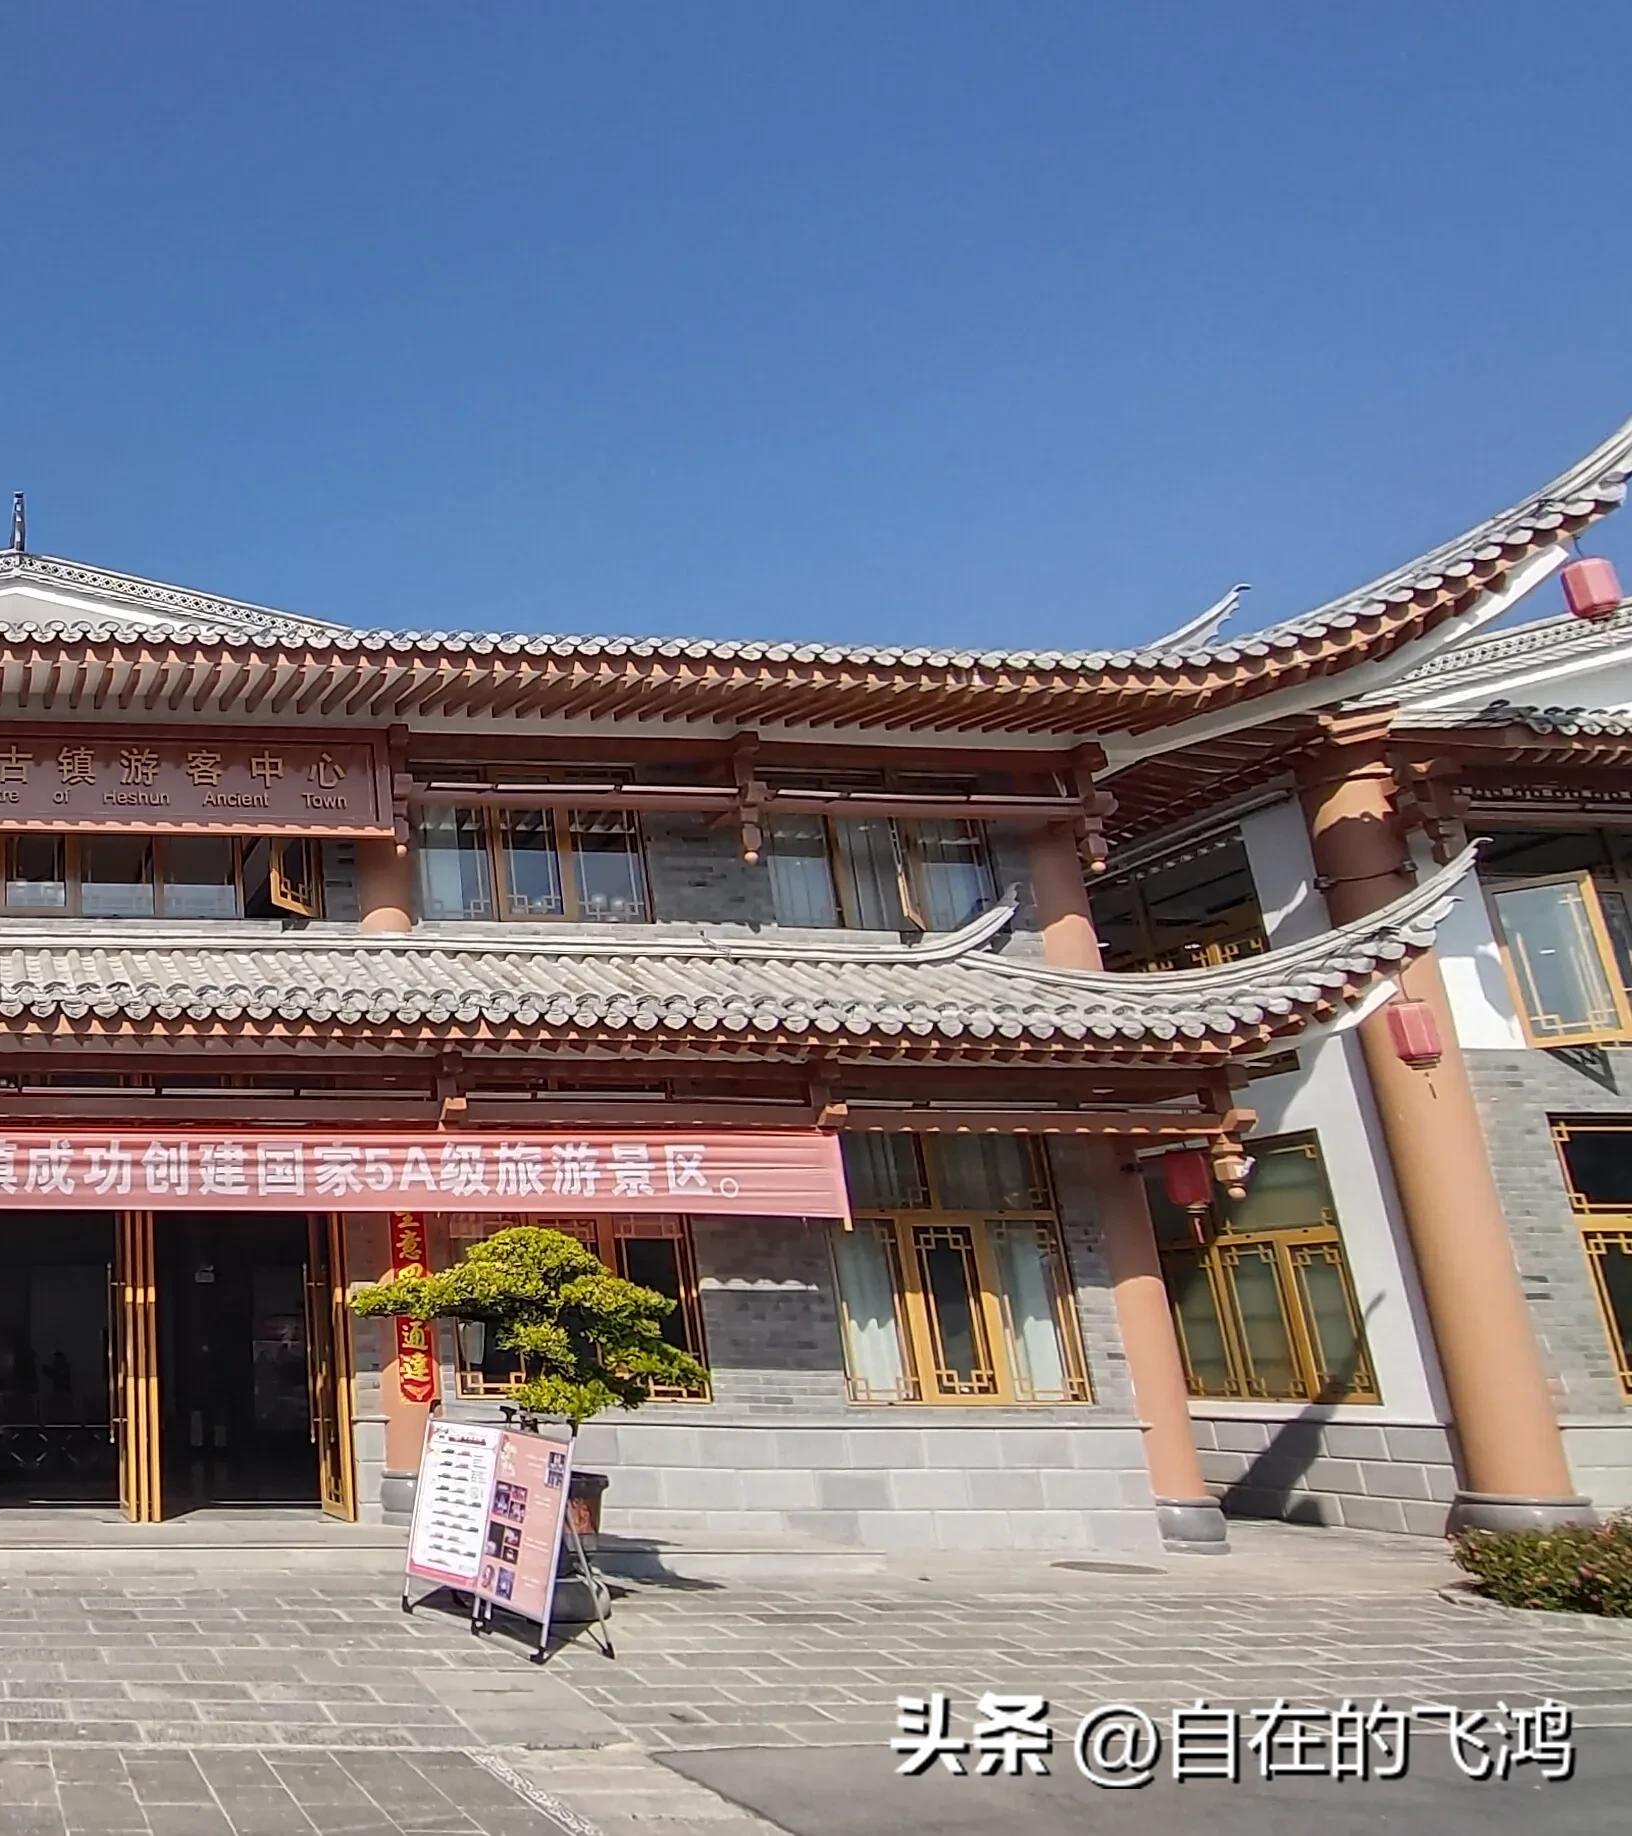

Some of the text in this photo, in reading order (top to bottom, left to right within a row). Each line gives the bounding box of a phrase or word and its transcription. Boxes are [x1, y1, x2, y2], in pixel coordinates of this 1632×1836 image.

[52, 788, 71, 805] of
[103, 789, 171, 807] Heshun
[202, 790, 270, 808] Ancient
[301, 792, 348, 809] Town
